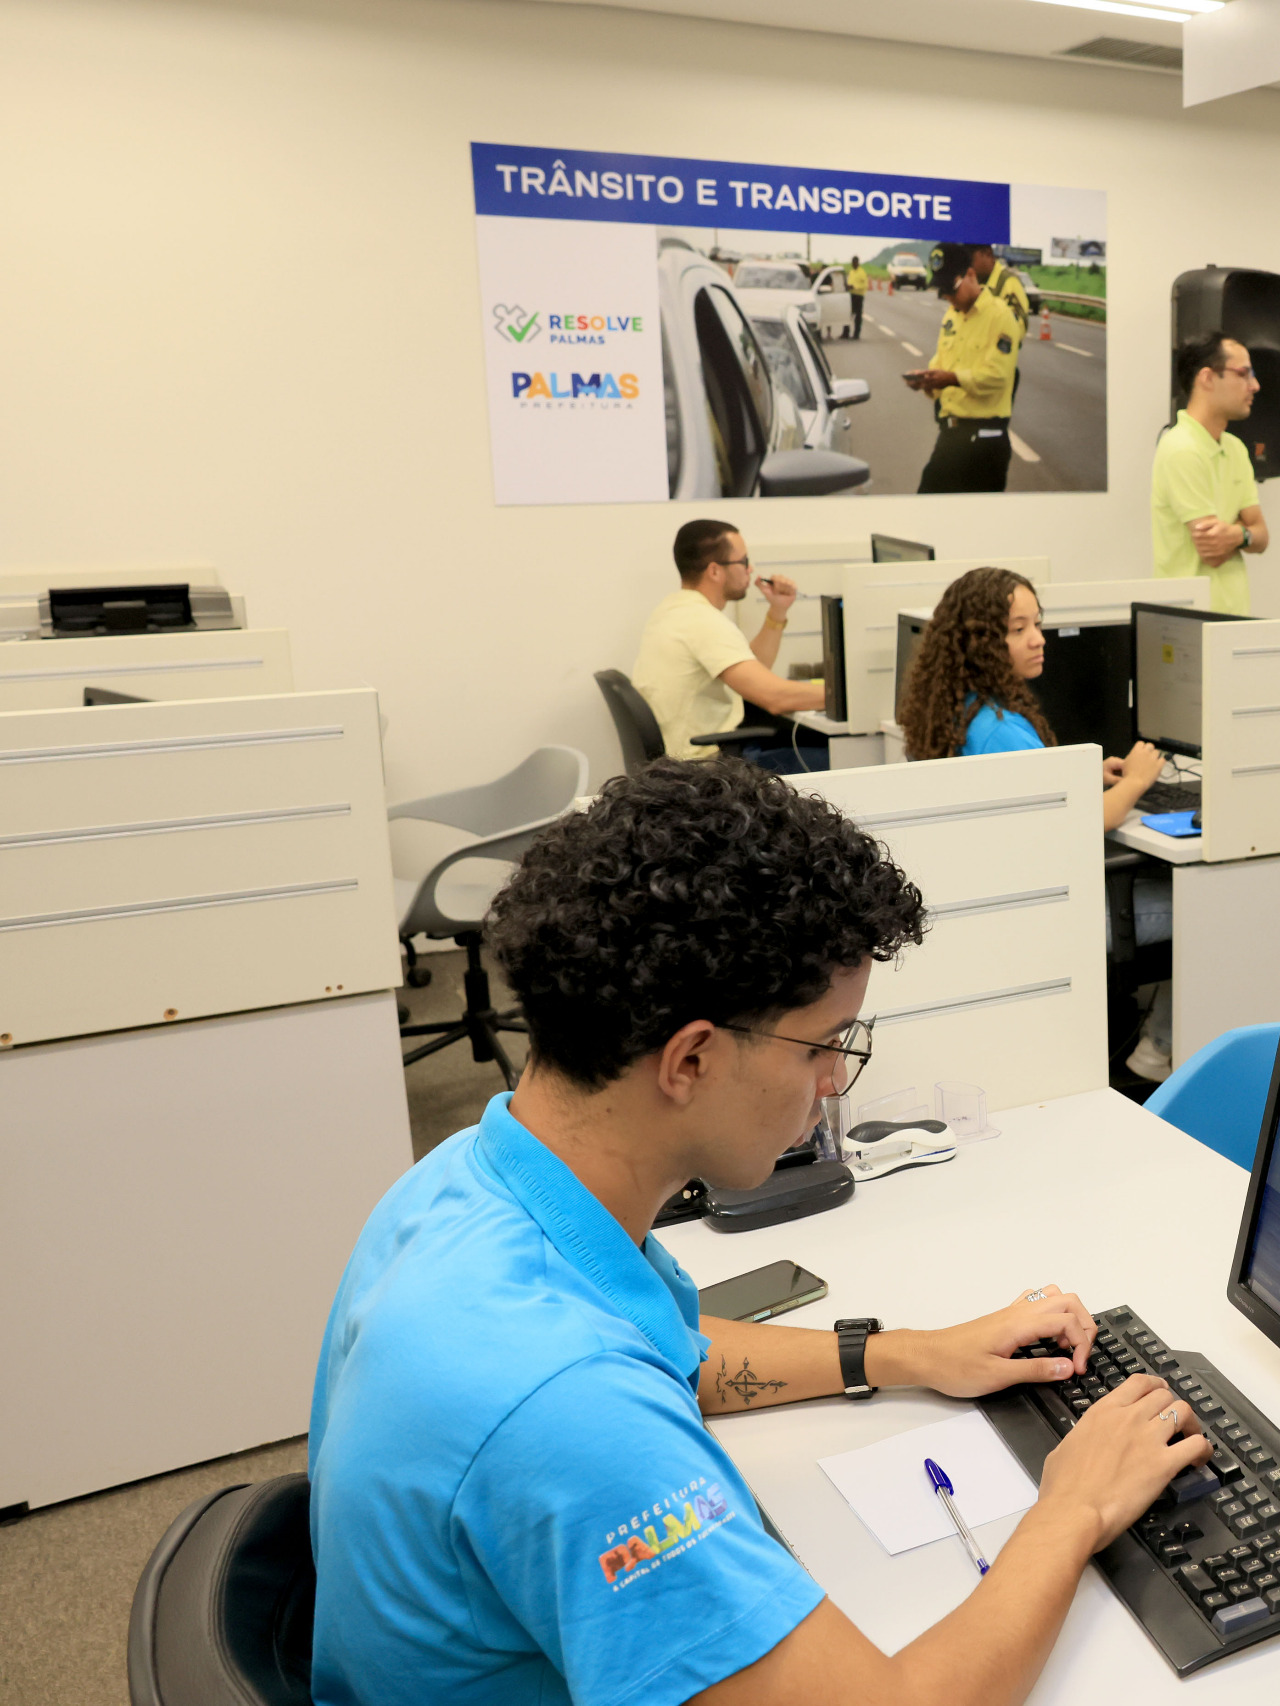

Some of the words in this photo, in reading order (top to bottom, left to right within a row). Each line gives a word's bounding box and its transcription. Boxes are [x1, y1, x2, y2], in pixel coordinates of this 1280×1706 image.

[495, 159, 684, 204] TRÂNSITO
[696, 178, 718, 206] E
[728, 181, 952, 221] TRANSPORTE
[549, 315, 643, 332] RESOLVE
[550, 335, 605, 344] PALMAS
[512, 372, 640, 398] PALMAS
[606, 1476, 707, 1544] PREFEITURA
[598, 1482, 728, 1584] PALMAS
